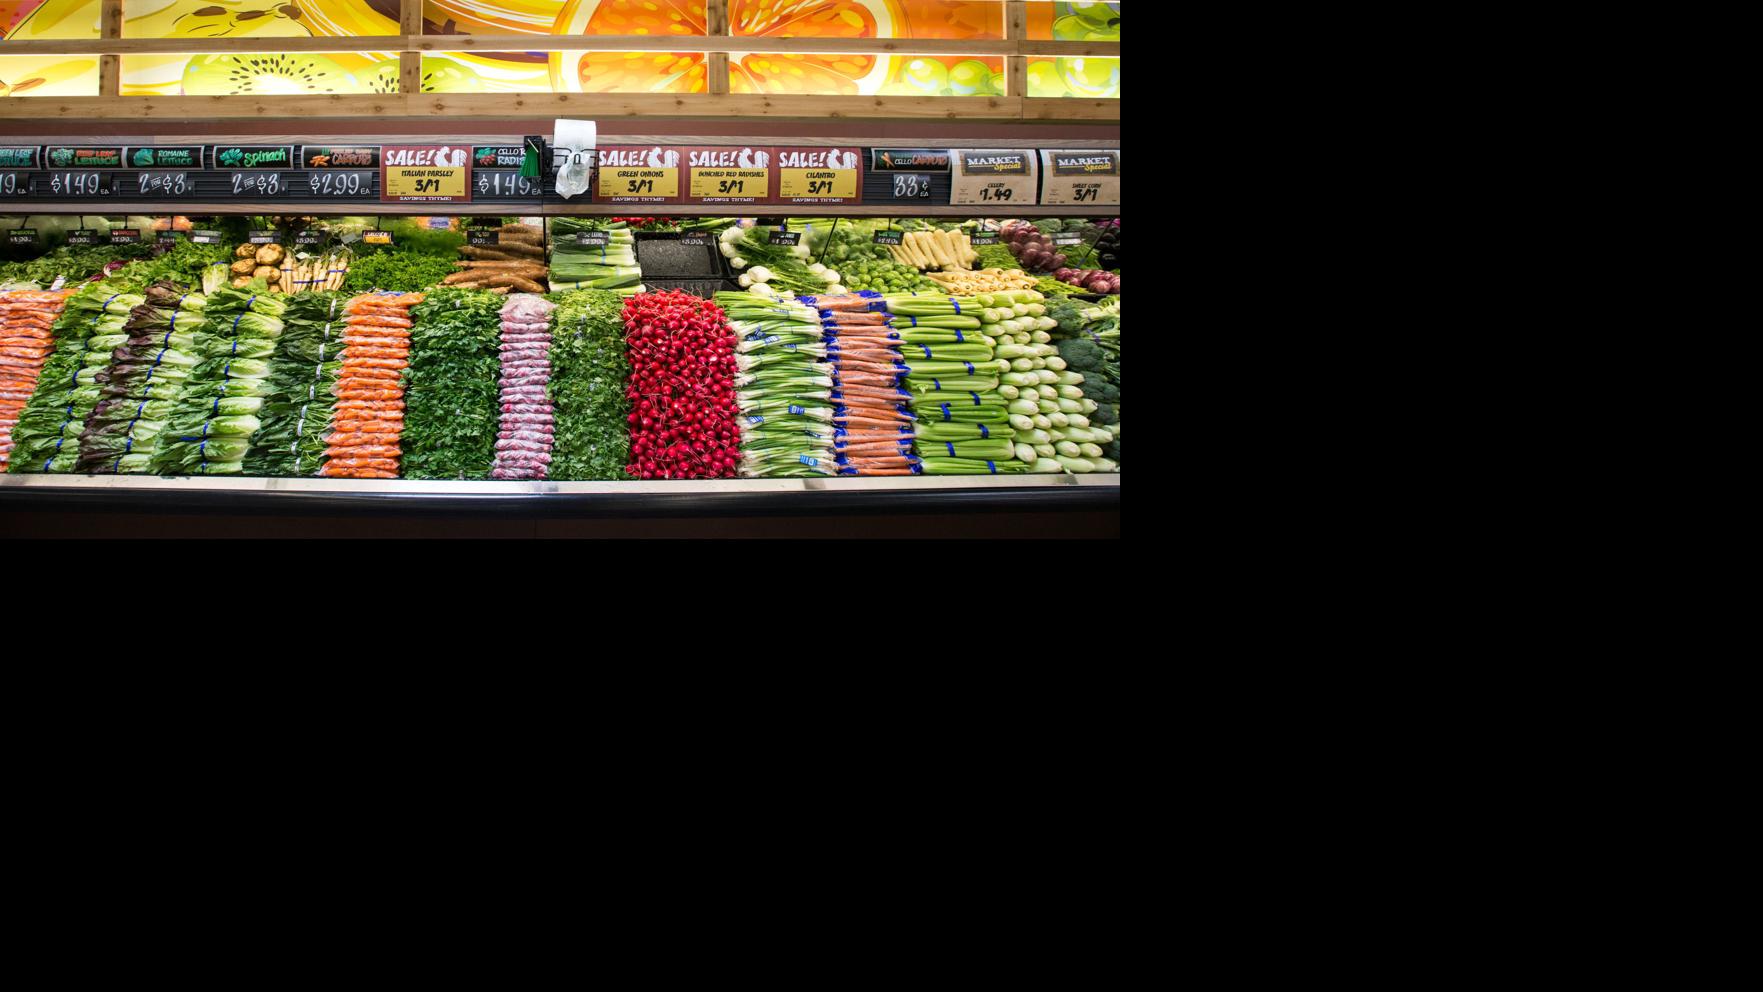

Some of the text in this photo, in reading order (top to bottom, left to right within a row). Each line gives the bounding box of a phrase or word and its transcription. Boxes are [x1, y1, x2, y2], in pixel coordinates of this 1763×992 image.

[385, 149, 436, 166] SALE!
[599, 150, 648, 166] SALE!
[689, 151, 738, 167] SALE!
[779, 152, 827, 168] SALE!
[968, 156, 1021, 166] MARKET
[1058, 157, 1111, 166] MARKET
[51, 173, 99, 194] $1.49
[139, 173, 149, 194] 2
[232, 173, 242, 195] 2
[310, 174, 359, 195] $2.99
